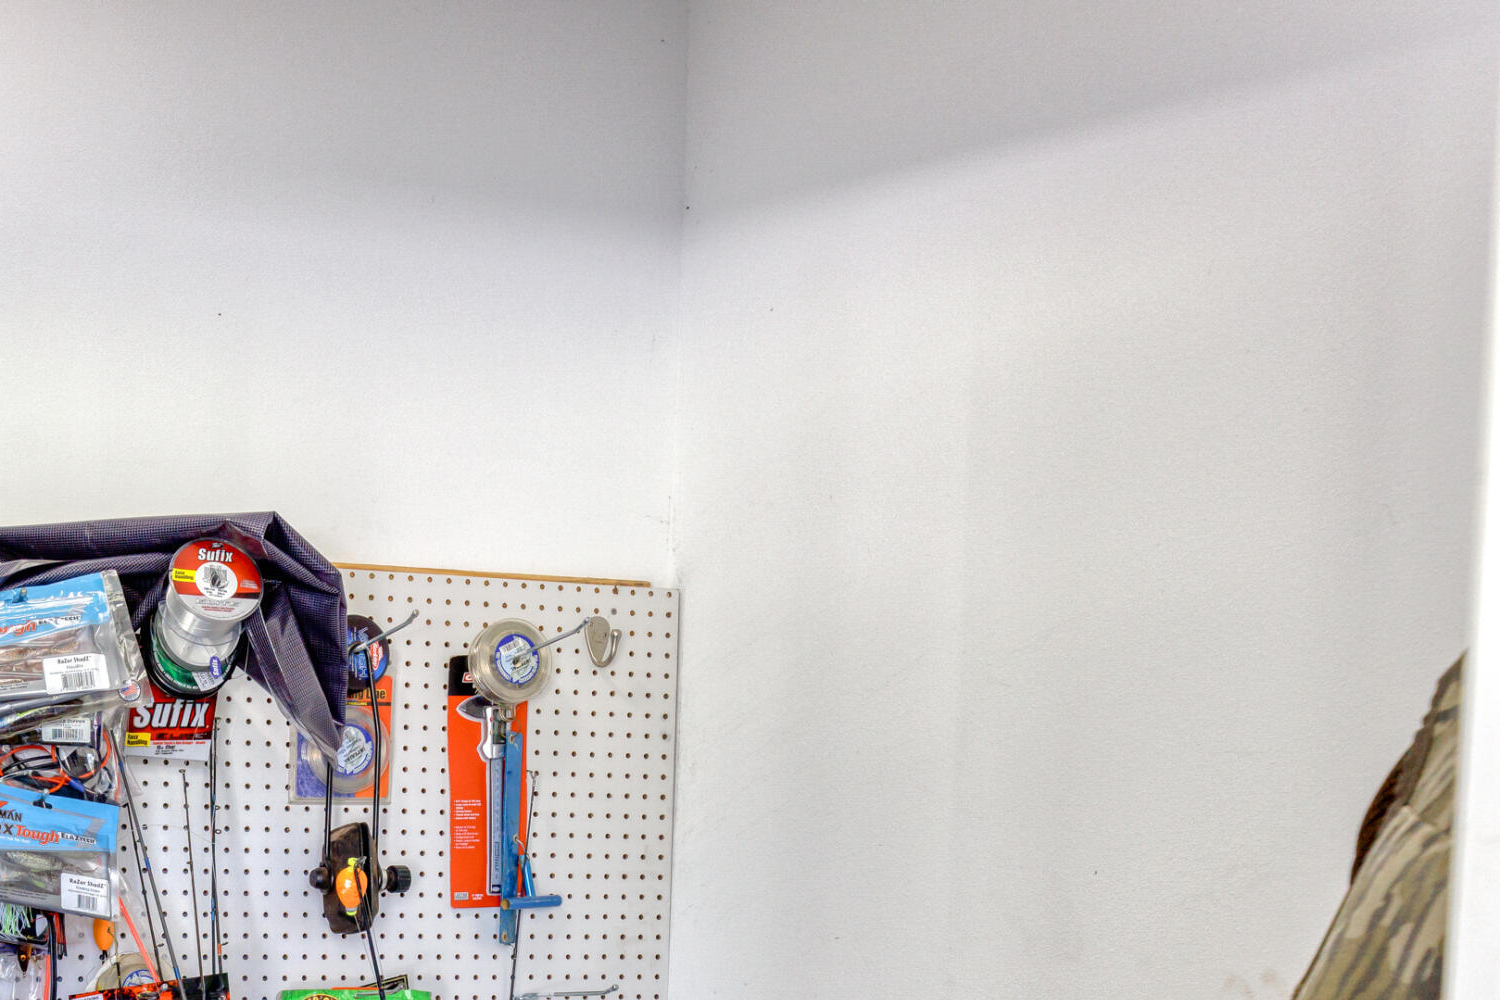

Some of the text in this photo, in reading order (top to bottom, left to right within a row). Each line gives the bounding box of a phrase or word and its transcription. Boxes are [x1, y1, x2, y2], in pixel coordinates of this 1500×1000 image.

[198, 548, 233, 562] Sufix
[133, 698, 210, 729] Sufix
[15, 825, 60, 845] Tough
